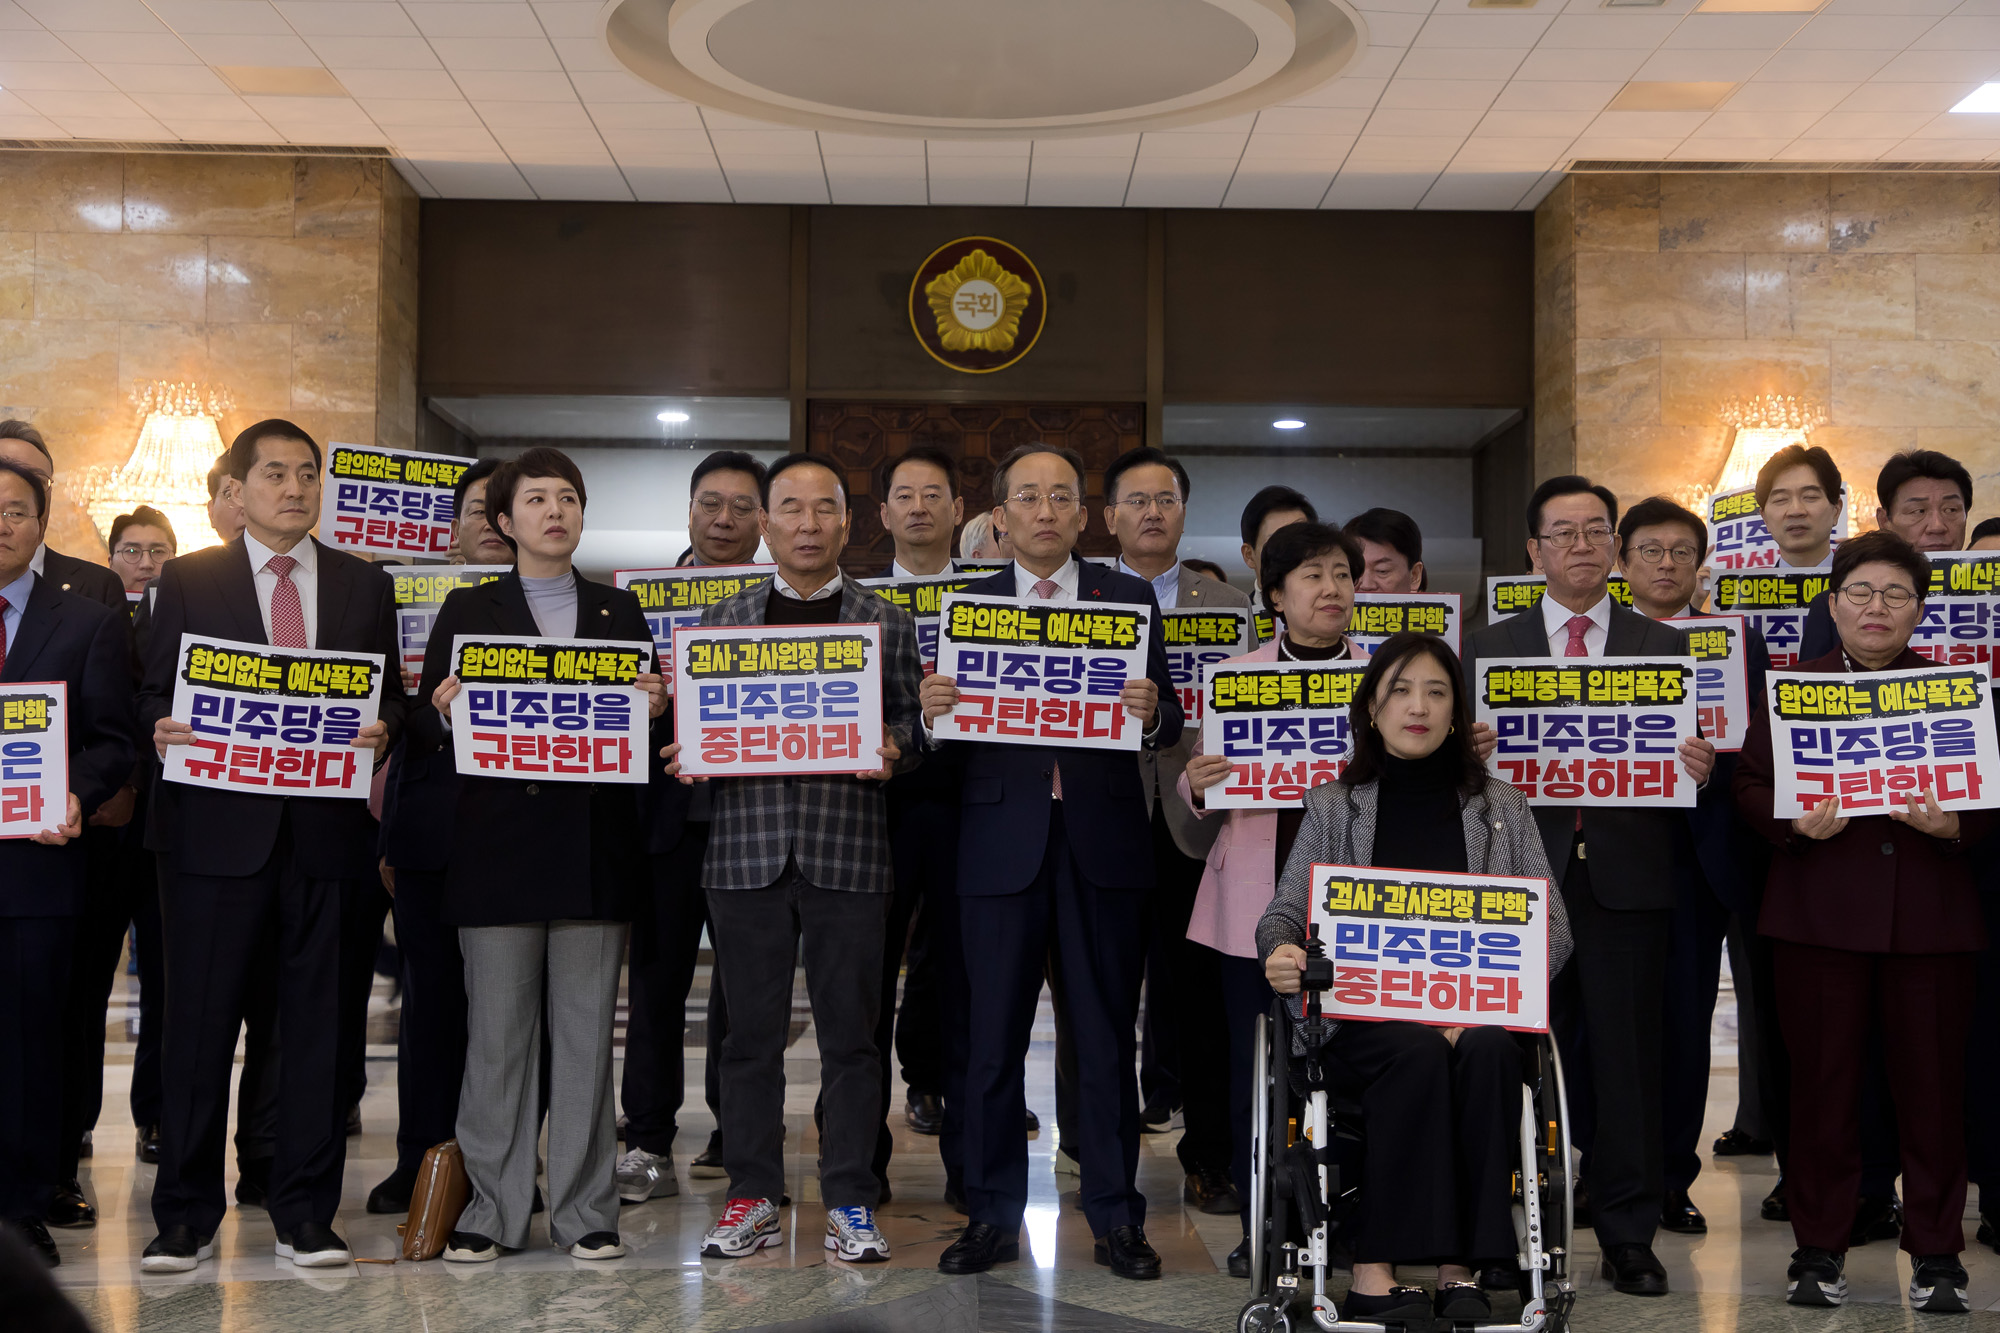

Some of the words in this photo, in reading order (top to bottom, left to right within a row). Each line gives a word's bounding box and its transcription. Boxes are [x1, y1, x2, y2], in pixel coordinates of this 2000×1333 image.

[956, 292, 998, 318] 국회
[335, 451, 401, 480] 합의없는
[337, 484, 454, 522] 민주당을
[1714, 493, 1760, 520] 탄핵중
[1717, 520, 1773, 551] 민주
[631, 579, 741, 608] 검사·감사원장
[1721, 579, 1797, 604] 합의없는
[952, 606, 1041, 641] 합의없는
[1047, 613, 1135, 645] 예산폭주
[1163, 618, 1236, 642] 예산폭주
[1350, 607, 1403, 632] 사원장
[1408, 607, 1444, 633] 탄핵
[692, 642, 818, 673] 검사·감사원장
[824, 640, 862, 669] 탄핵
[1689, 631, 1727, 657] 탄핵
[189, 648, 282, 689] 합의없는
[288, 662, 370, 695] 예산폭주
[462, 647, 548, 678] 합의없는
[554, 651, 638, 681] 예산폭주
[957, 651, 1127, 696] 민주당을
[700, 682, 859, 721] 민주당은
[1216, 675, 1302, 706] 탄핵중독
[1308, 673, 1365, 703] 입법
[1489, 670, 1581, 701] 탄핵중독
[1588, 670, 1682, 701] 입법폭주
[1779, 684, 1872, 715] 합의없는
[1878, 677, 1976, 712] 예산폭주
[4, 699, 46, 730] 탄핵
[191, 694, 360, 745] 민주당을
[469, 690, 630, 730] 민주당을
[954, 693, 1125, 739] 규탄한다
[473, 732, 632, 773] 규탄한다
[701, 724, 861, 763] 중단하라
[1498, 714, 1676, 753] 민주당은
[1791, 719, 1976, 766] 민주당을
[185, 739, 356, 788] 규탄한다
[1498, 759, 1677, 798] 각성하라
[1797, 762, 1982, 811] 규탄한다
[1330, 882, 1475, 918] 검사·감사원장
[1481, 892, 1526, 922] 탄핵
[1336, 923, 1521, 970] 민주당은
[1333, 966, 1522, 1013] 중단하라
